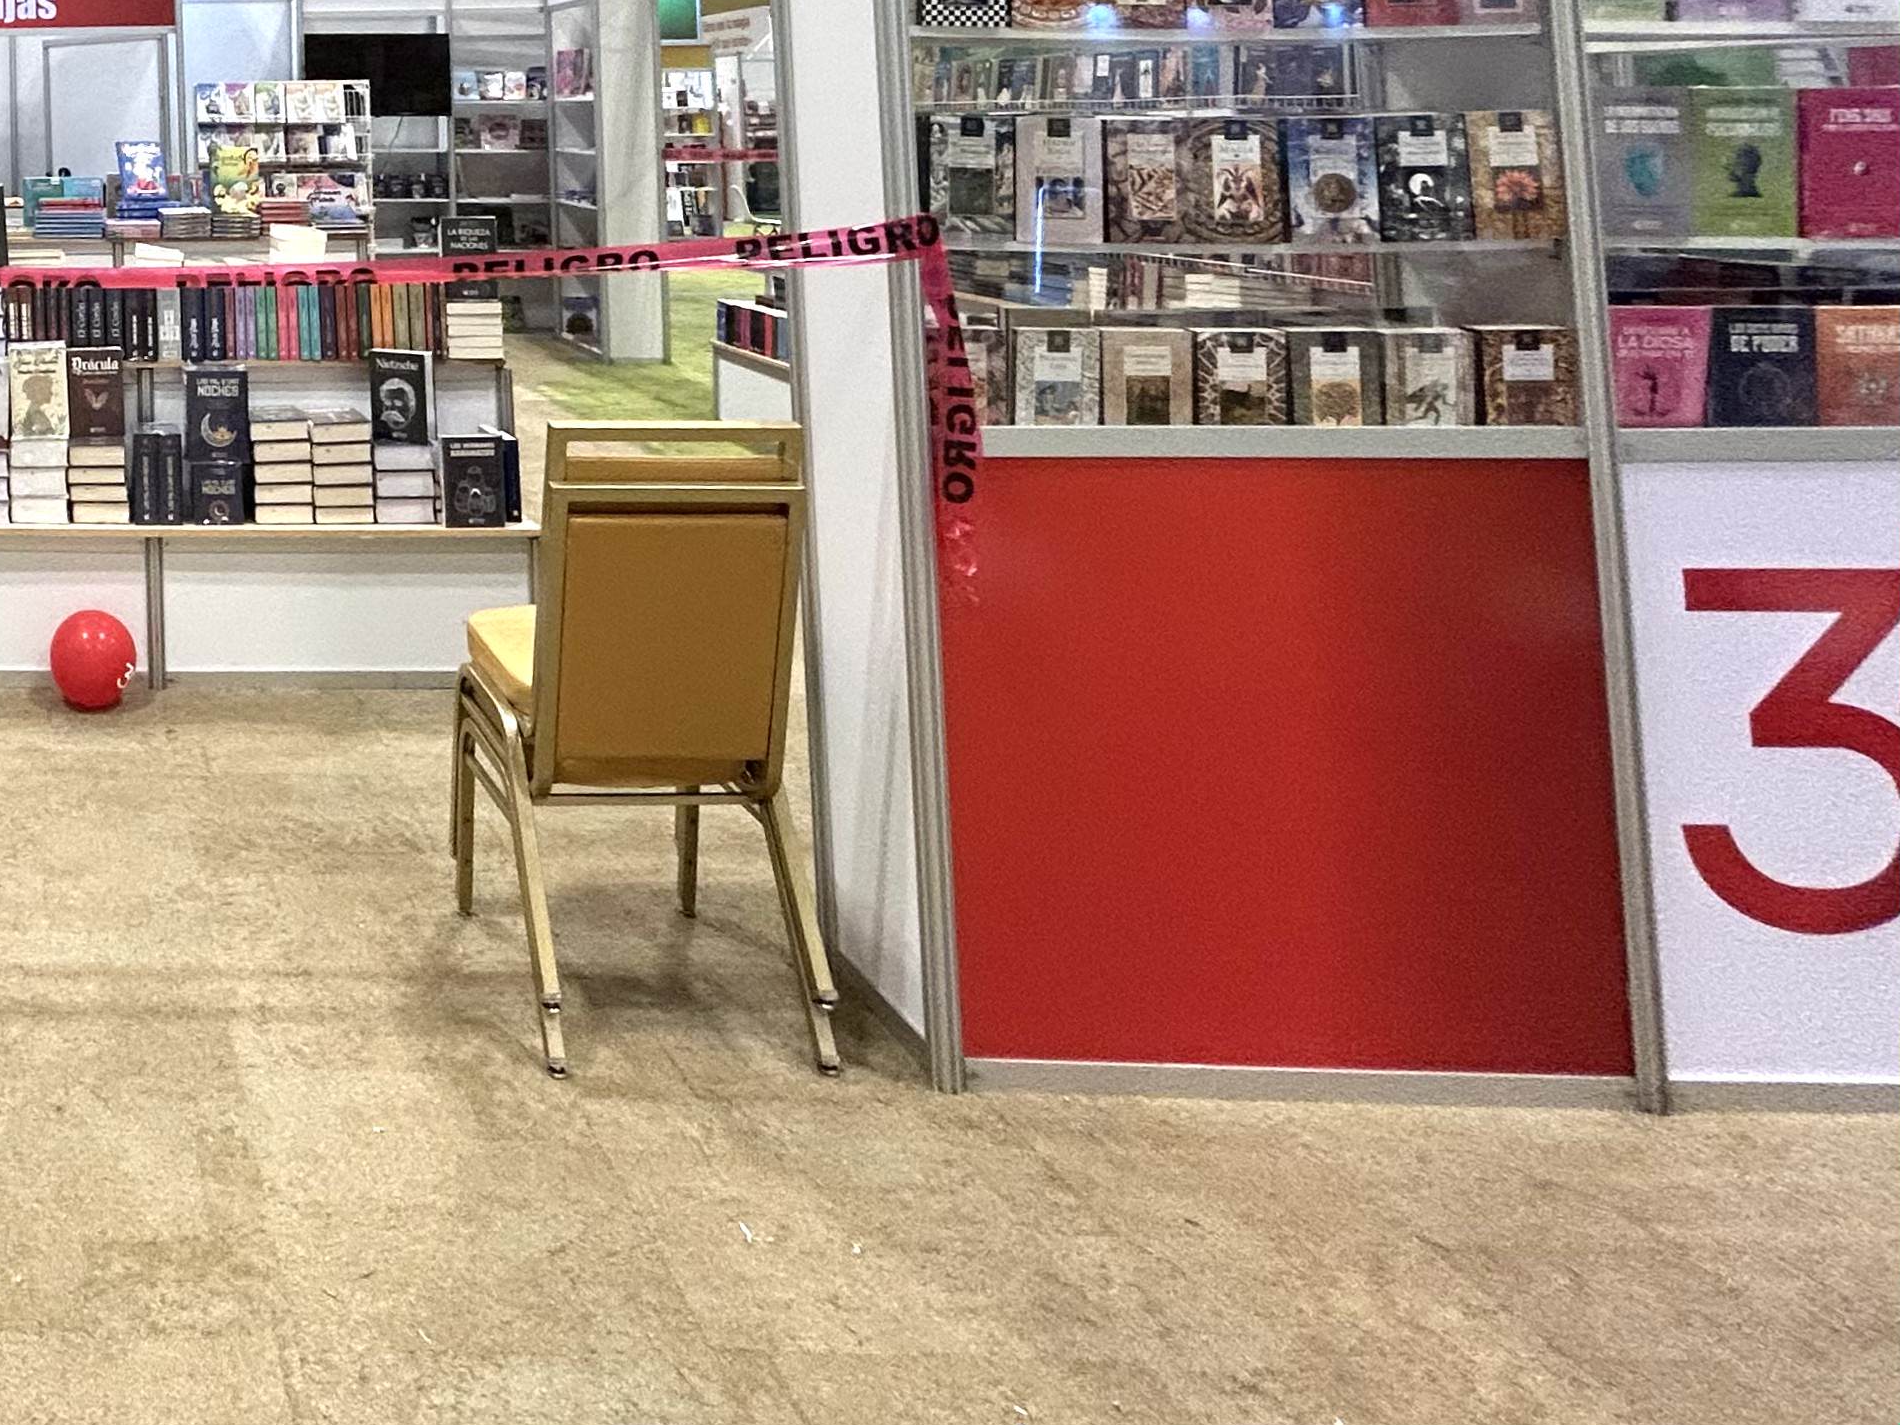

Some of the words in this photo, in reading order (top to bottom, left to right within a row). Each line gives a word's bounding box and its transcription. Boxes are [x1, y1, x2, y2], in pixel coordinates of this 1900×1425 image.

[71, 357, 119, 375] Drácula
[375, 357, 420, 371] Nietzsche
[197, 386, 239, 397] NOCHES
